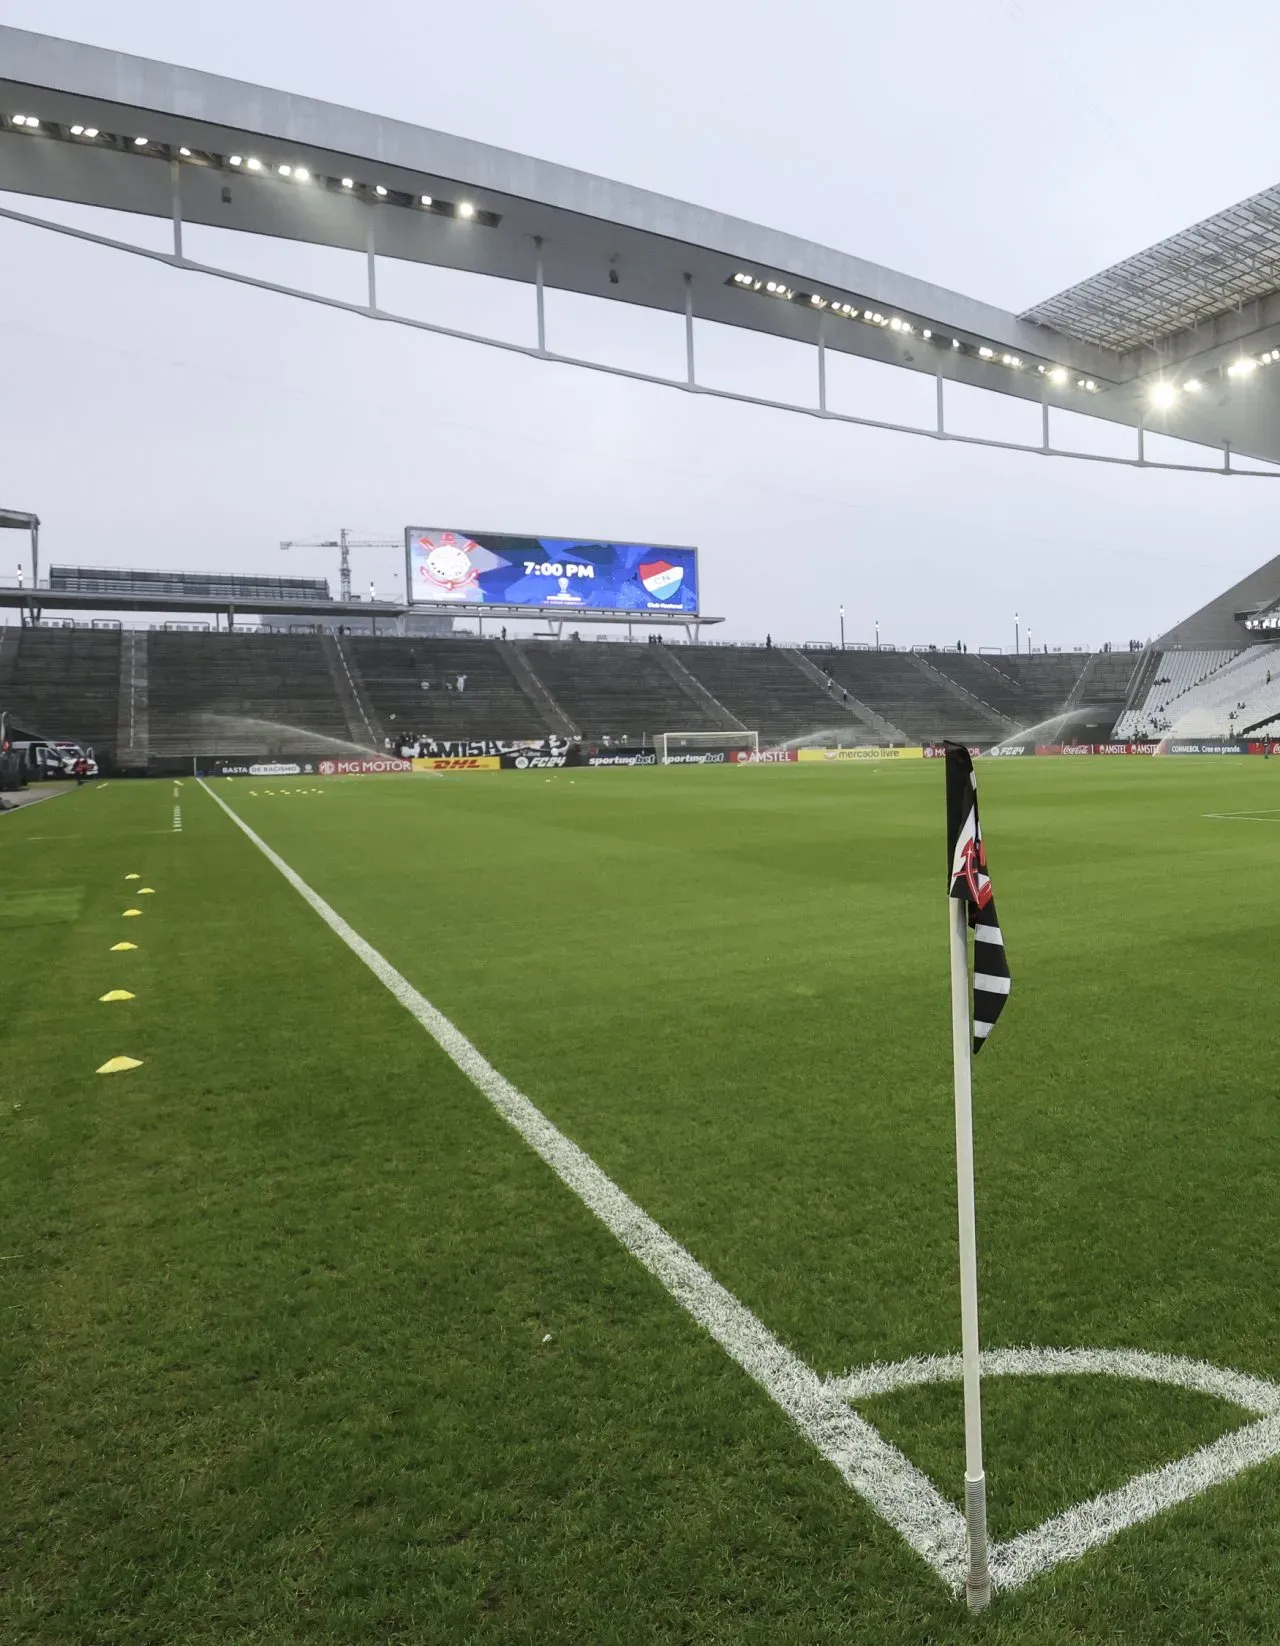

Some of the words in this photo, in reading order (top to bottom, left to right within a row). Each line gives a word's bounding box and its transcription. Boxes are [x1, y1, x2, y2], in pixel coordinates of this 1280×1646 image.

[523, 561, 563, 577] 7:00
[566, 564, 595, 579] PM
[839, 749, 879, 759] mercado
[880, 749, 900, 758] livre
[1105, 744, 1127, 754] AMSTEL
[1171, 745, 1200, 753] CONMEBOL
[589, 753, 656, 766] sportingbet
[749, 749, 792, 762] AMSTEL
[337, 761, 360, 773] MG
[362, 760, 412, 772] MOTOR
[433, 759, 480, 769] DHL
